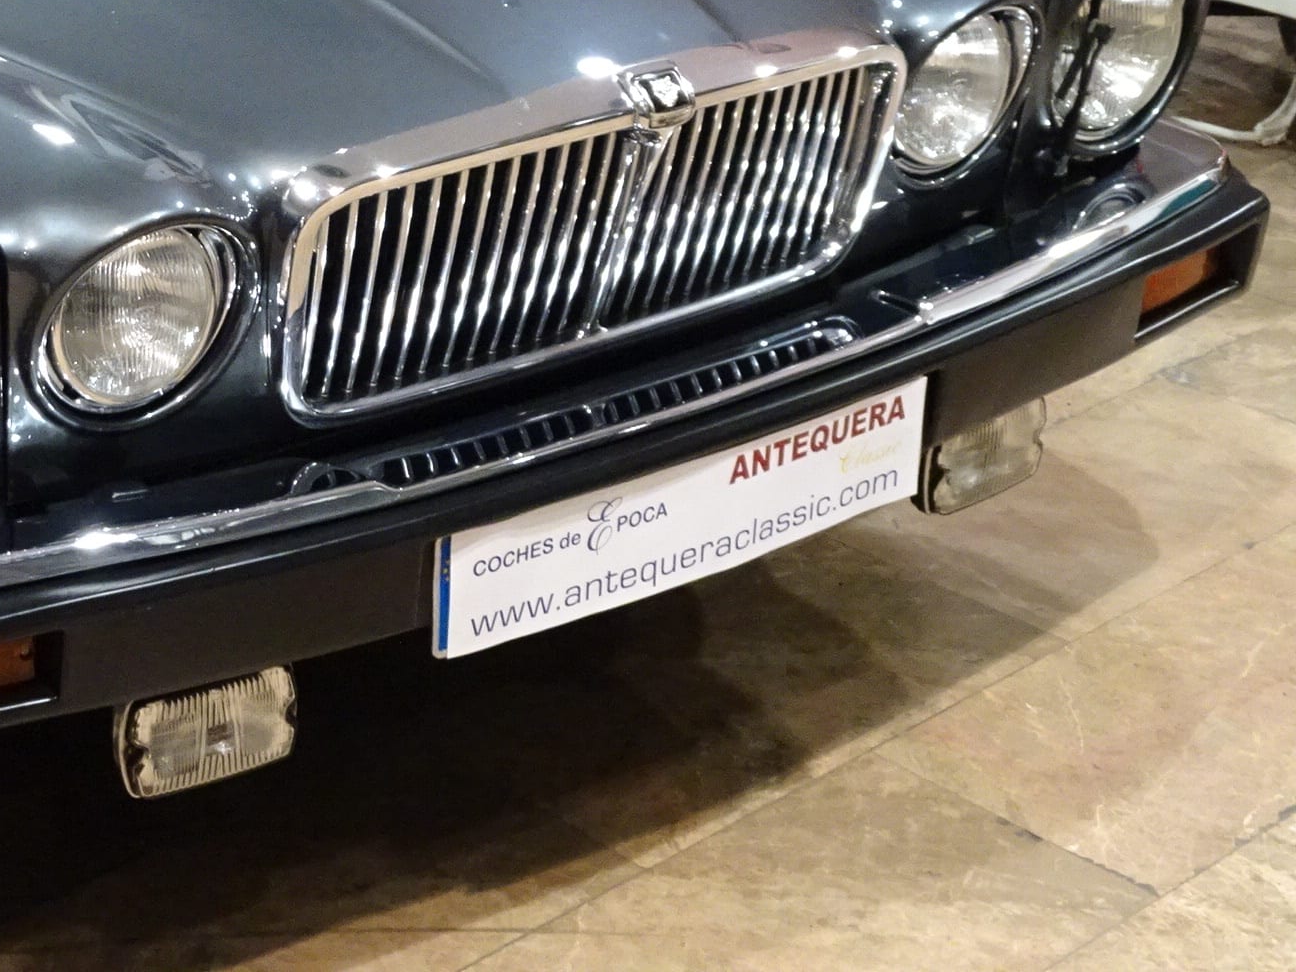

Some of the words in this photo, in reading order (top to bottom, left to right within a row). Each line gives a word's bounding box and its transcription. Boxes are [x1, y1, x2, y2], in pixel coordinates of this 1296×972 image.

[729, 395, 906, 485] ANTEQUERA
[470, 469, 898, 637] www.antequeraclassic.com
[472, 537, 554, 577] COCHES
[559, 532, 582, 550] de
